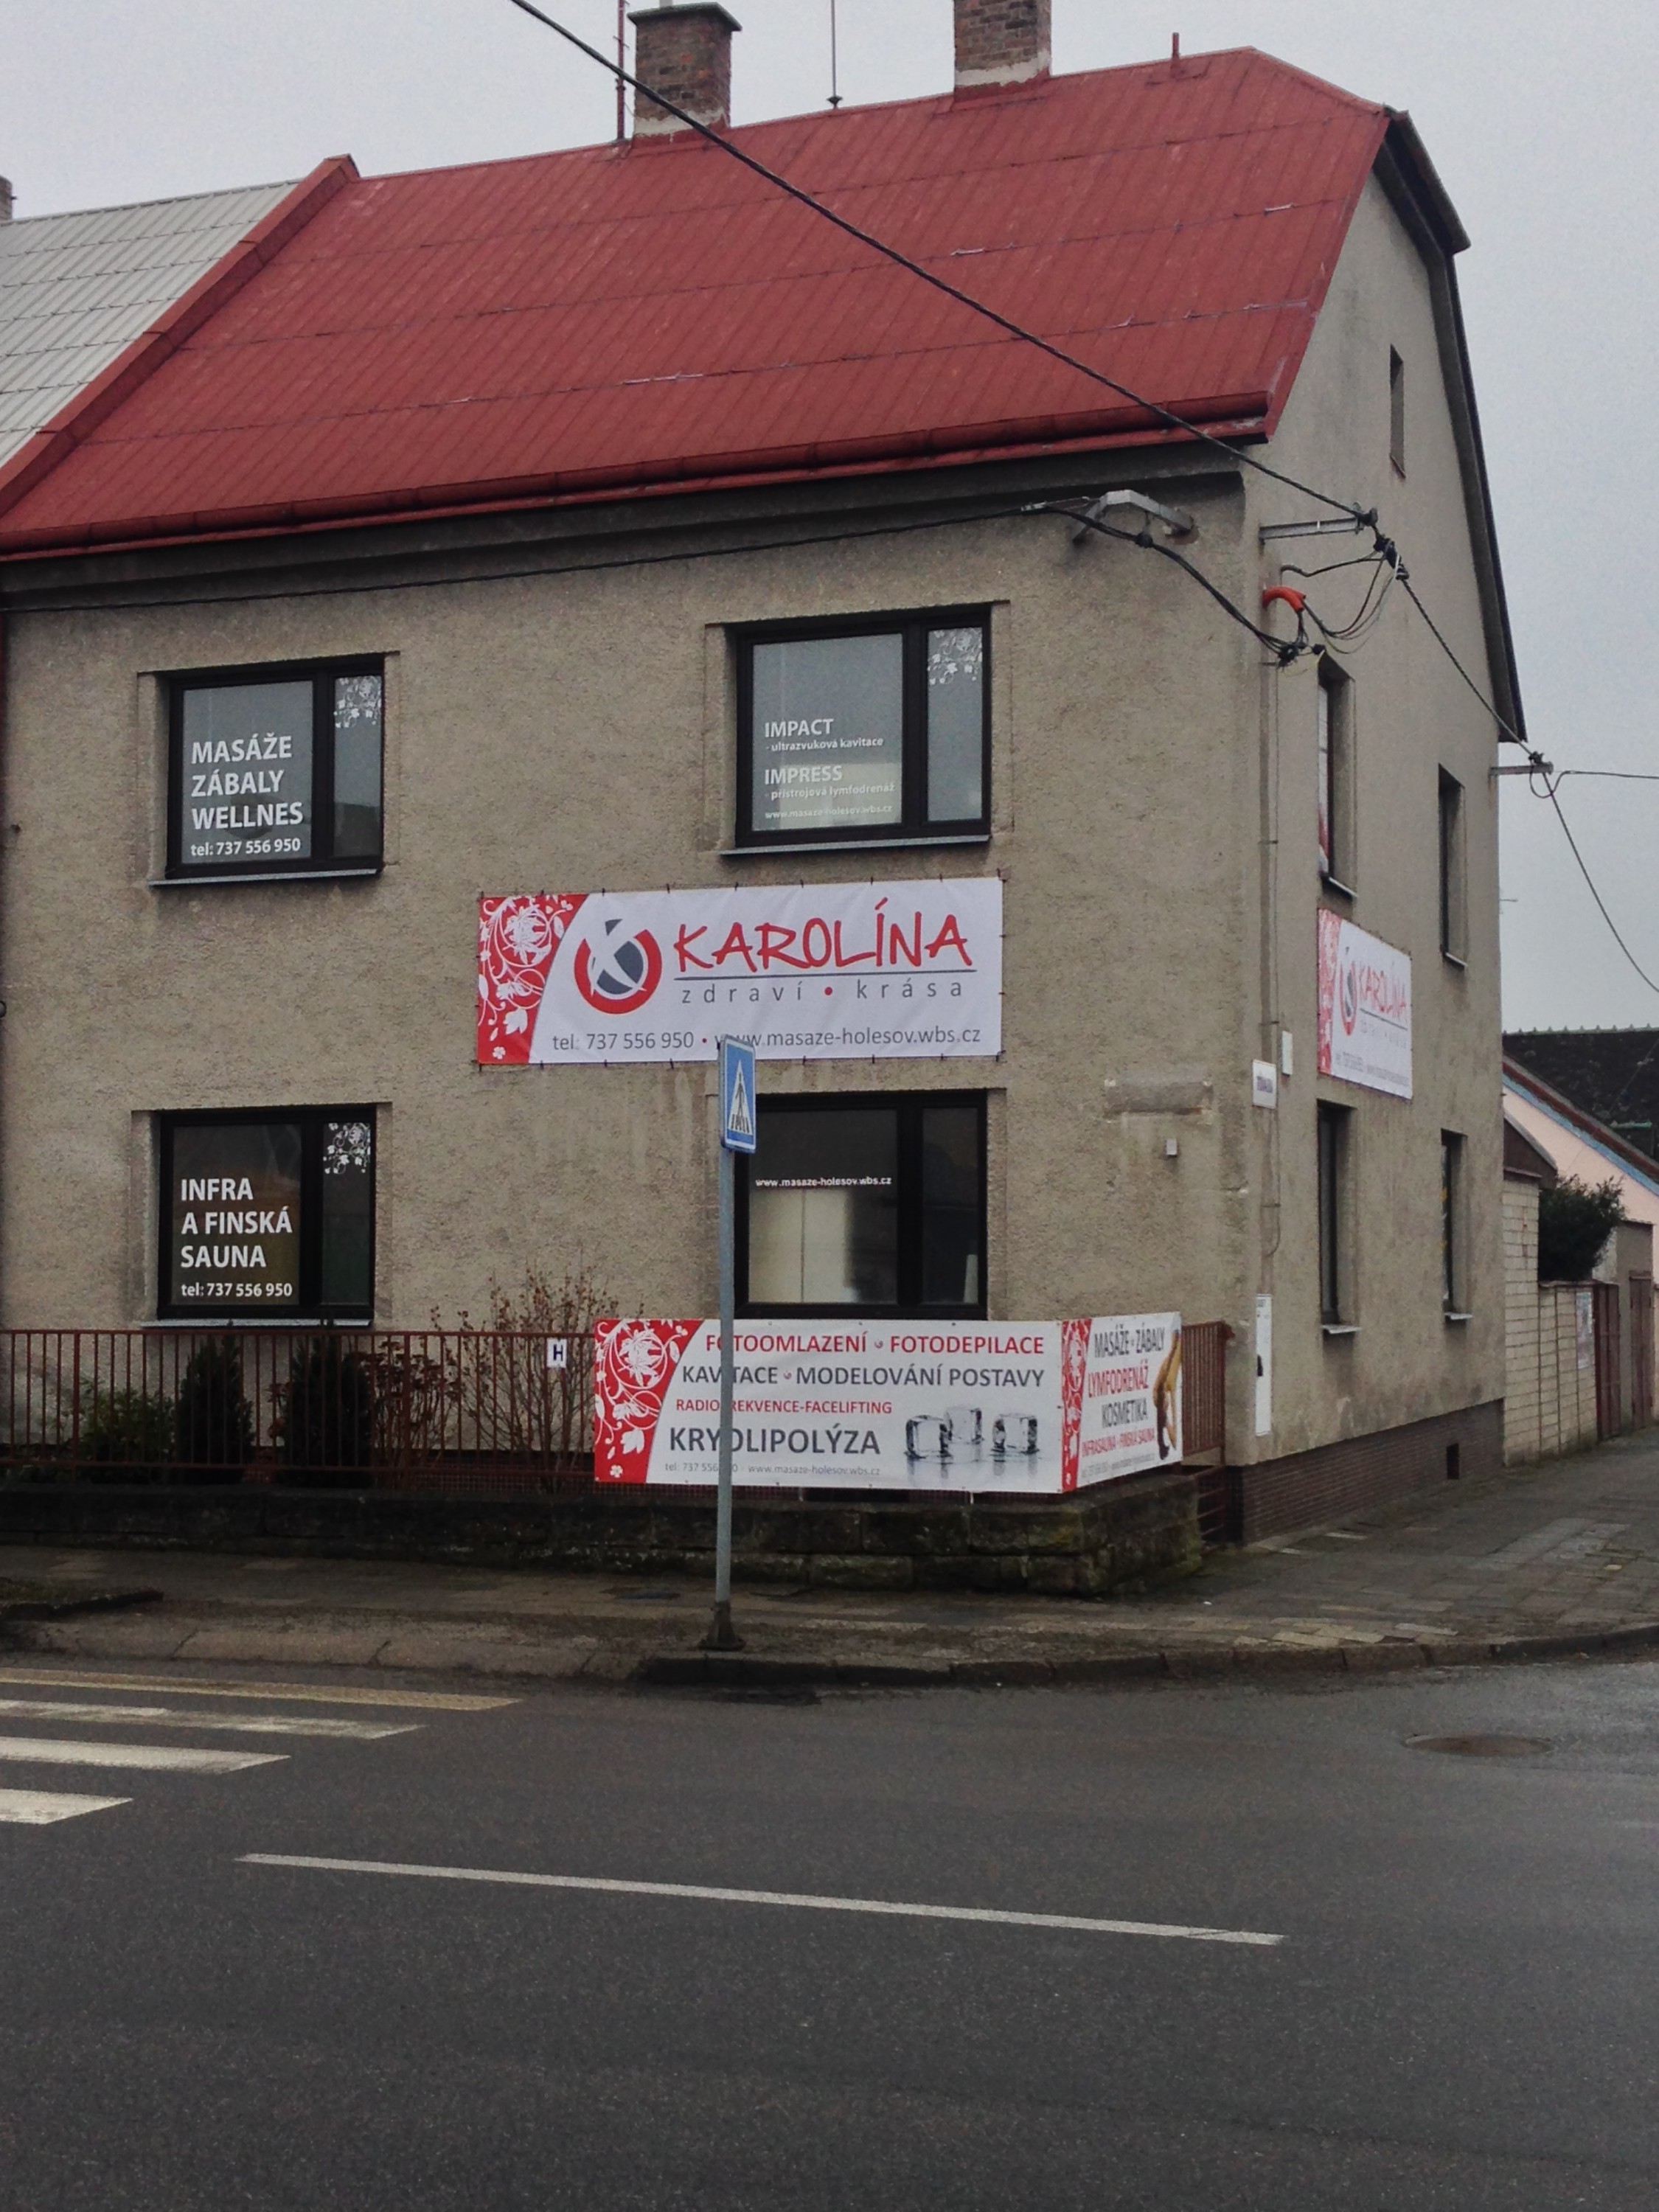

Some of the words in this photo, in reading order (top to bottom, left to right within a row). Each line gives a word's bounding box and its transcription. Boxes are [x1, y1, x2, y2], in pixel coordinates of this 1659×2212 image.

[765, 718, 834, 737] IMPACT
[191, 732, 292, 764] MASÁŽE
[771, 739, 838, 751] ultrazvuková
[840, 737, 884, 748] kavitace
[191, 769, 285, 797] ZÁBALY
[765, 765, 843, 785] IMPRESS
[191, 801, 303, 830] WELLNES
[190, 842, 214, 856] tel:
[216, 841, 242, 855] 737
[246, 839, 271, 854] 556
[274, 838, 301, 852] 950
[674, 897, 973, 973] KAROLÍNA
[682, 980, 804, 1004] zdraví
[857, 978, 963, 998] krása
[586, 1034, 617, 1050] 737
[623, 1032, 655, 1049] 556
[661, 1032, 694, 1048] 950
[714, 1026, 981, 1047] w.masaze-holesov.wbs.cz
[181, 1178, 254, 1201] INFRA
[181, 1212, 198, 1235] A
[205, 1206, 293, 1234] FINSKÁ
[181, 1245, 266, 1268] SAUNA
[181, 1282, 204, 1296] tel:
[206, 1283, 232, 1296] 737
[235, 1283, 262, 1296] 556
[265, 1283, 293, 1296] 950
[890, 1336, 1045, 1354] FOTODEPILACE
[1094, 1324, 1130, 1358] MASÁŽE
[1135, 1323, 1165, 1354] ZÁBALY
[553, 1343, 563, 1362] H
[683, 1366, 778, 1384] KAVTACE
[796, 1363, 943, 1386] MODELOVÁNÍ
[949, 1368, 1045, 1388] POSTAVY
[1088, 1359, 1150, 1399] LYMFODRENÁŽ
[676, 1399, 893, 1414] RADIOREKVENCE-FACELIFTING
[1102, 1398, 1148, 1429] KOSMETIKA
[683, 1463, 698, 1472] 737
[701, 1463, 719, 1472] 556
